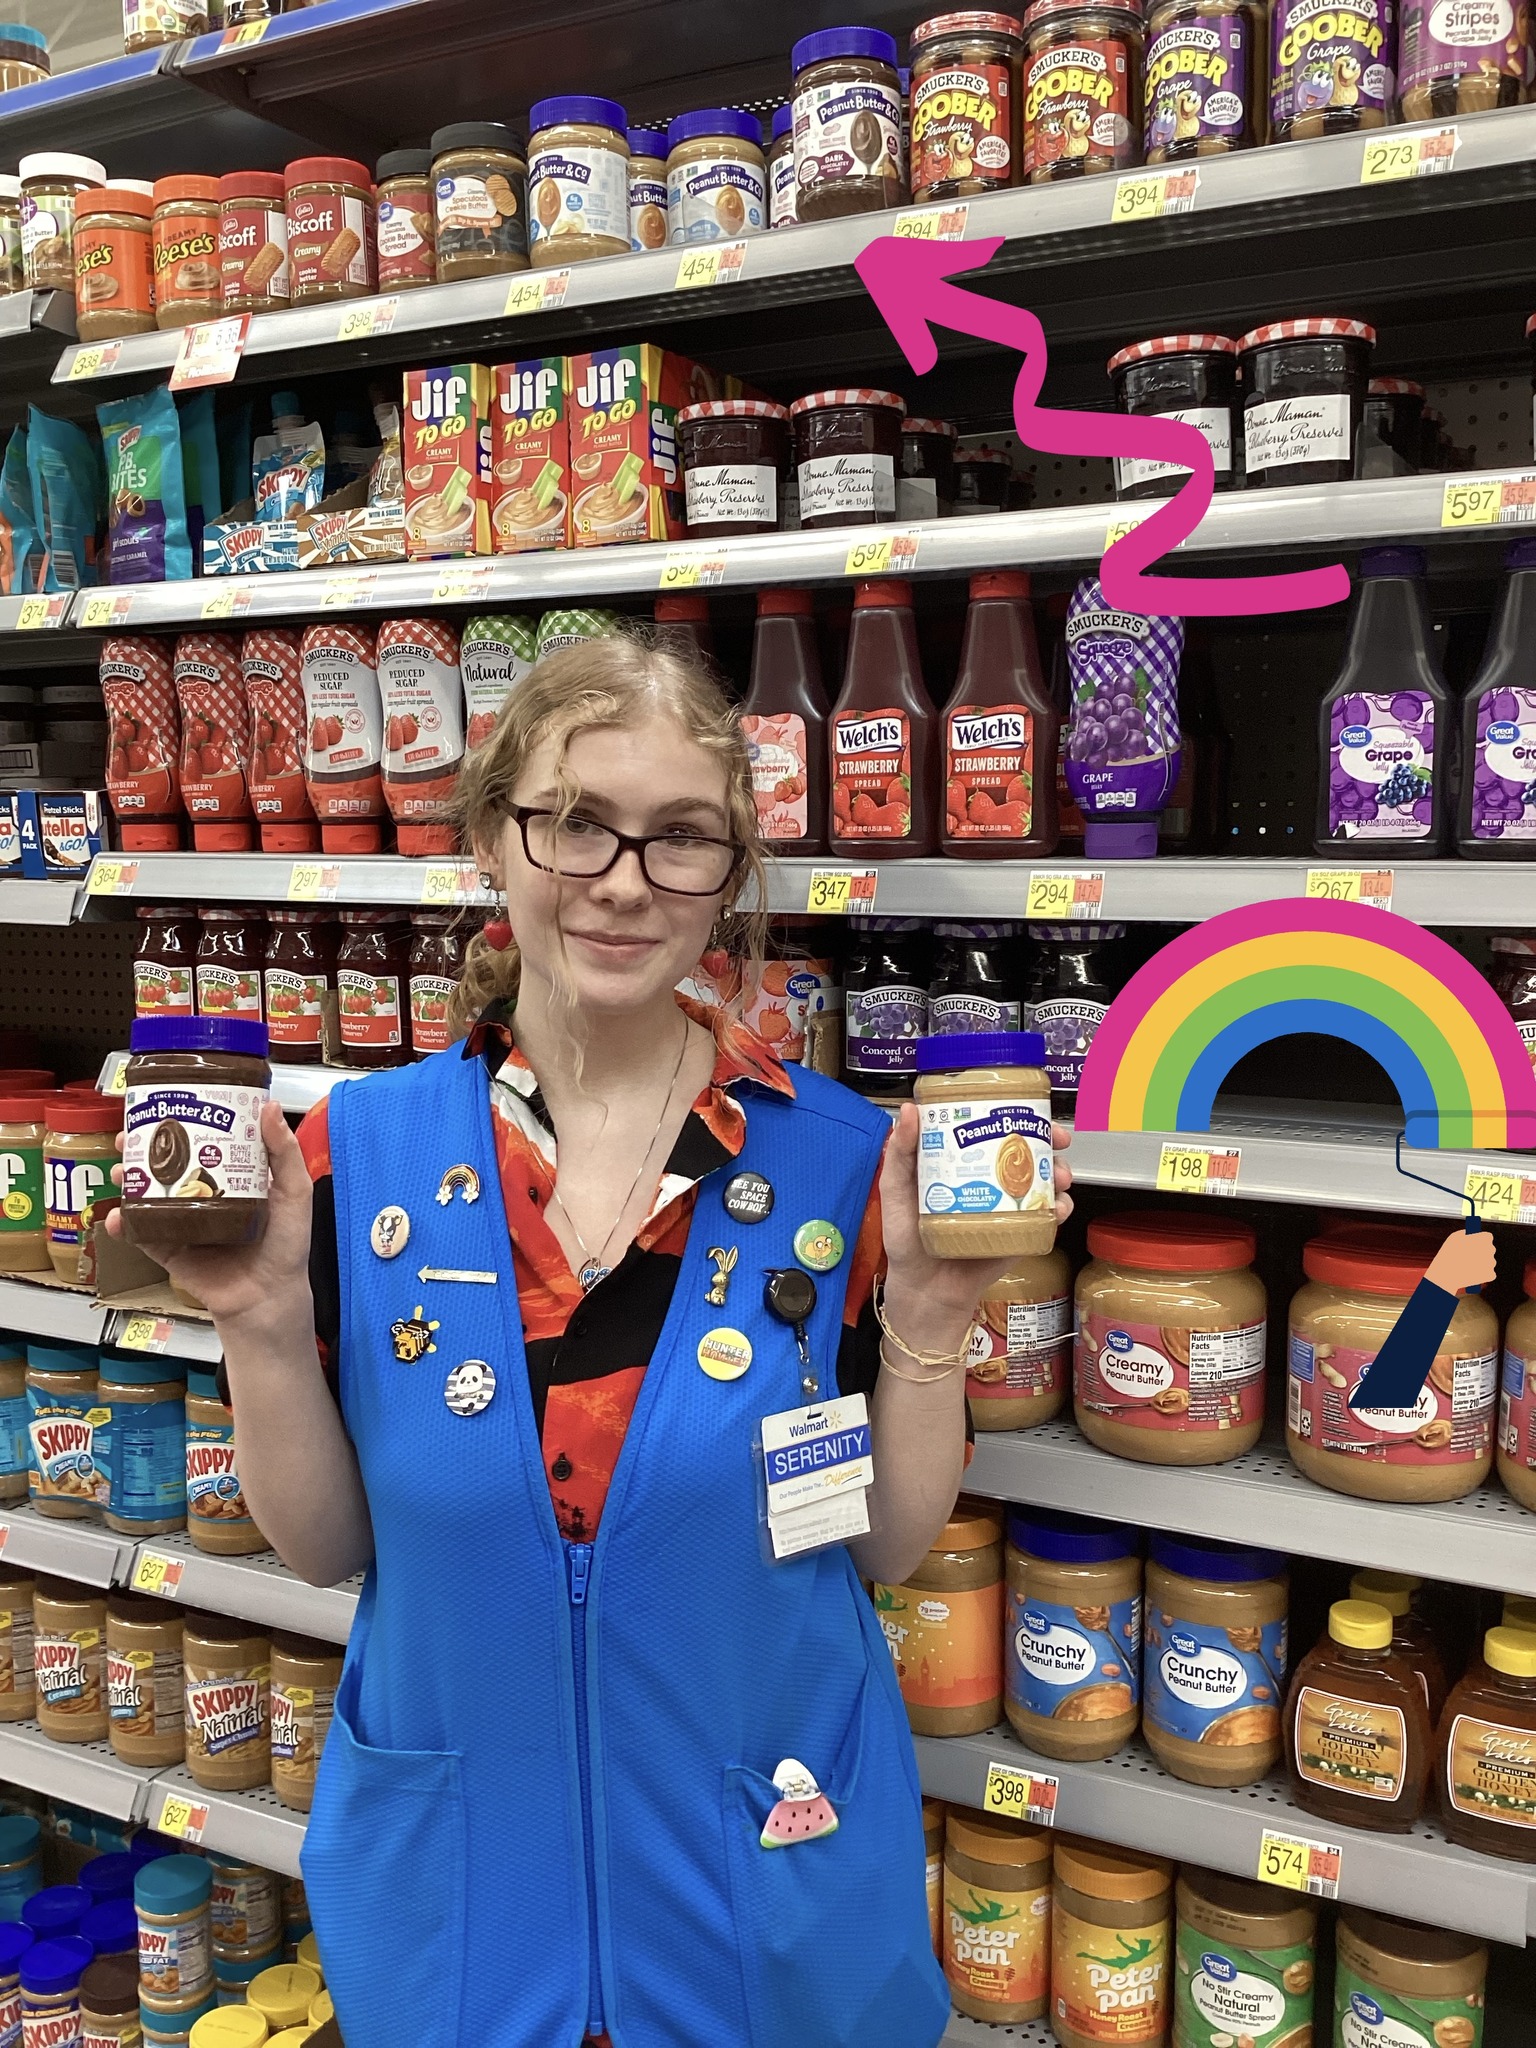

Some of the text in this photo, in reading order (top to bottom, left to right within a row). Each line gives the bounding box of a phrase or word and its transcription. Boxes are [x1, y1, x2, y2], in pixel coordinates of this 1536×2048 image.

[1445, 11, 1499, 29] Stripes
[1147, 29, 1216, 70] SMUCKER'S
[1280, 12, 1383, 66] GOOBER
[1307, 42, 1351, 60] Grape
[1030, 50, 1101, 80] SMUCKER'S
[916, 74, 984, 102] SMUCKER'S
[1144, 50, 1228, 107] GOOBER
[1157, 79, 1193, 97] Grape
[1026, 69, 1113, 122] GOOBER
[912, 91, 996, 142] GOOBER
[1038, 99, 1089, 120] Strawberry
[923, 121, 973, 139] Strawberry
[824, 153, 844, 163] DARK
[500, 368, 558, 414] Jif
[577, 358, 636, 408] Jif
[412, 376, 466, 421] Jif
[583, 398, 636, 440] TO GO
[1270, 403, 1322, 425] Maman
[416, 417, 466, 452] TO GO
[504, 408, 557, 445] TO GO
[1290, 422, 1344, 442] Preserves
[515, 440, 542, 451] CREAMY
[593, 433, 621, 444] CREAMY
[426, 446, 452, 457] CREAMY
[315, 517, 348, 539] SKIPPY
[413, 526, 422, 541] 8
[226, 527, 263, 556] SKIPPY
[1068, 614, 1143, 638] SMUCKER'S
[305, 645, 354, 665] SMUCKER'S
[381, 644, 430, 664] SMUCKER'S
[463, 641, 510, 657] SMUCKER'S
[313, 672, 349, 682] REDUCED
[389, 670, 424, 680] REDUCED
[465, 661, 517, 682] Natural
[319, 681, 343, 690] SUGAR
[395, 678, 418, 688] SUGAR
[840, 721, 898, 749] Welch's
[955, 718, 1021, 747] Welch's
[839, 758, 899, 775] STRAWBERRY
[954, 755, 1020, 772] STRAWBERRY
[1365, 749, 1413, 764] Grape
[854, 779, 882, 788] SPREAD
[972, 776, 1001, 786] SPREAD
[1082, 772, 1113, 785] GRAPE
[22, 820, 35, 841] 4
[60, 836, 87, 851] &GO!
[865, 991, 927, 1008] SMUCKER'S
[935, 1002, 996, 1020] SMUCKER'S
[861, 1045, 900, 1057] Concord
[888, 1056, 903, 1065] Jelly
[1059, 1073, 1077, 1082] Jelly
[126, 1101, 231, 1127] Peanut Butter & Co
[959, 1121, 1002, 1144] Peanut
[1003, 1117, 1037, 1134] Butter
[1036, 1121, 1045, 1137] &
[204, 1146, 216, 1156] 6g
[45, 1163, 104, 1211] Jif
[740, 1191, 768, 1203] SPACE
[753, 1182, 770, 1193] YOU
[961, 1187, 991, 1196] WHITE
[1009, 1305, 1036, 1313] Nutrition
[1191, 1333, 1221, 1342] Nutrition
[1191, 1342, 1210, 1350] Facts
[705, 1338, 751, 1359] HUNTER
[1106, 1354, 1164, 1377] Creamy
[1454, 1359, 1480, 1370] Nutrition
[1454, 1369, 1471, 1378] Facts
[1106, 1370, 1165, 1386] Peanut Butter
[789, 1417, 829, 1438] Walmart
[37, 1423, 90, 1460] SKIPPY
[775, 1431, 865, 1476] SERENITY
[779, 1490, 788, 1500] Our
[788, 1487, 801, 1498] People
[802, 1484, 813, 1494] Make
[823, 1466, 863, 1487] Difference
[1021, 1633, 1086, 1663] Crunchy
[1022, 1649, 1085, 1671] Peanut Butter
[1167, 1657, 1238, 1684] Crunchy
[38, 1663, 87, 1692] Natural
[1168, 1672, 1236, 1694] Peanut Butter
[193, 1685, 256, 1720] SKIPPY
[202, 1704, 264, 1744] Natural
[1329, 1716, 1374, 1736] Lakes
[1317, 1736, 1381, 1759] GOLDEN
[1329, 1734, 1370, 1748] PREMIUM
[1321, 1747, 1375, 1768] HONEY
[1485, 1746, 1533, 1765] Lakes
[1486, 1763, 1528, 1779] PREMIUM
[1477, 1777, 1534, 1798] HONEY
[950, 1912, 1020, 1948] Peter
[954, 1939, 1010, 1966] Pan
[971, 1969, 995, 1979] Roast
[1086, 1962, 1163, 1991] Peter
[1095, 1986, 1156, 2013] Pan
[1202, 1977, 1274, 2005] No Stir Creamy
[1199, 1998, 1276, 2023] Peanut Butter Spread
[1214, 1993, 1260, 2013] Natural
[1090, 2009, 1143, 2023] Honey Roast
[24, 2014, 81, 2047] SKIPPY
